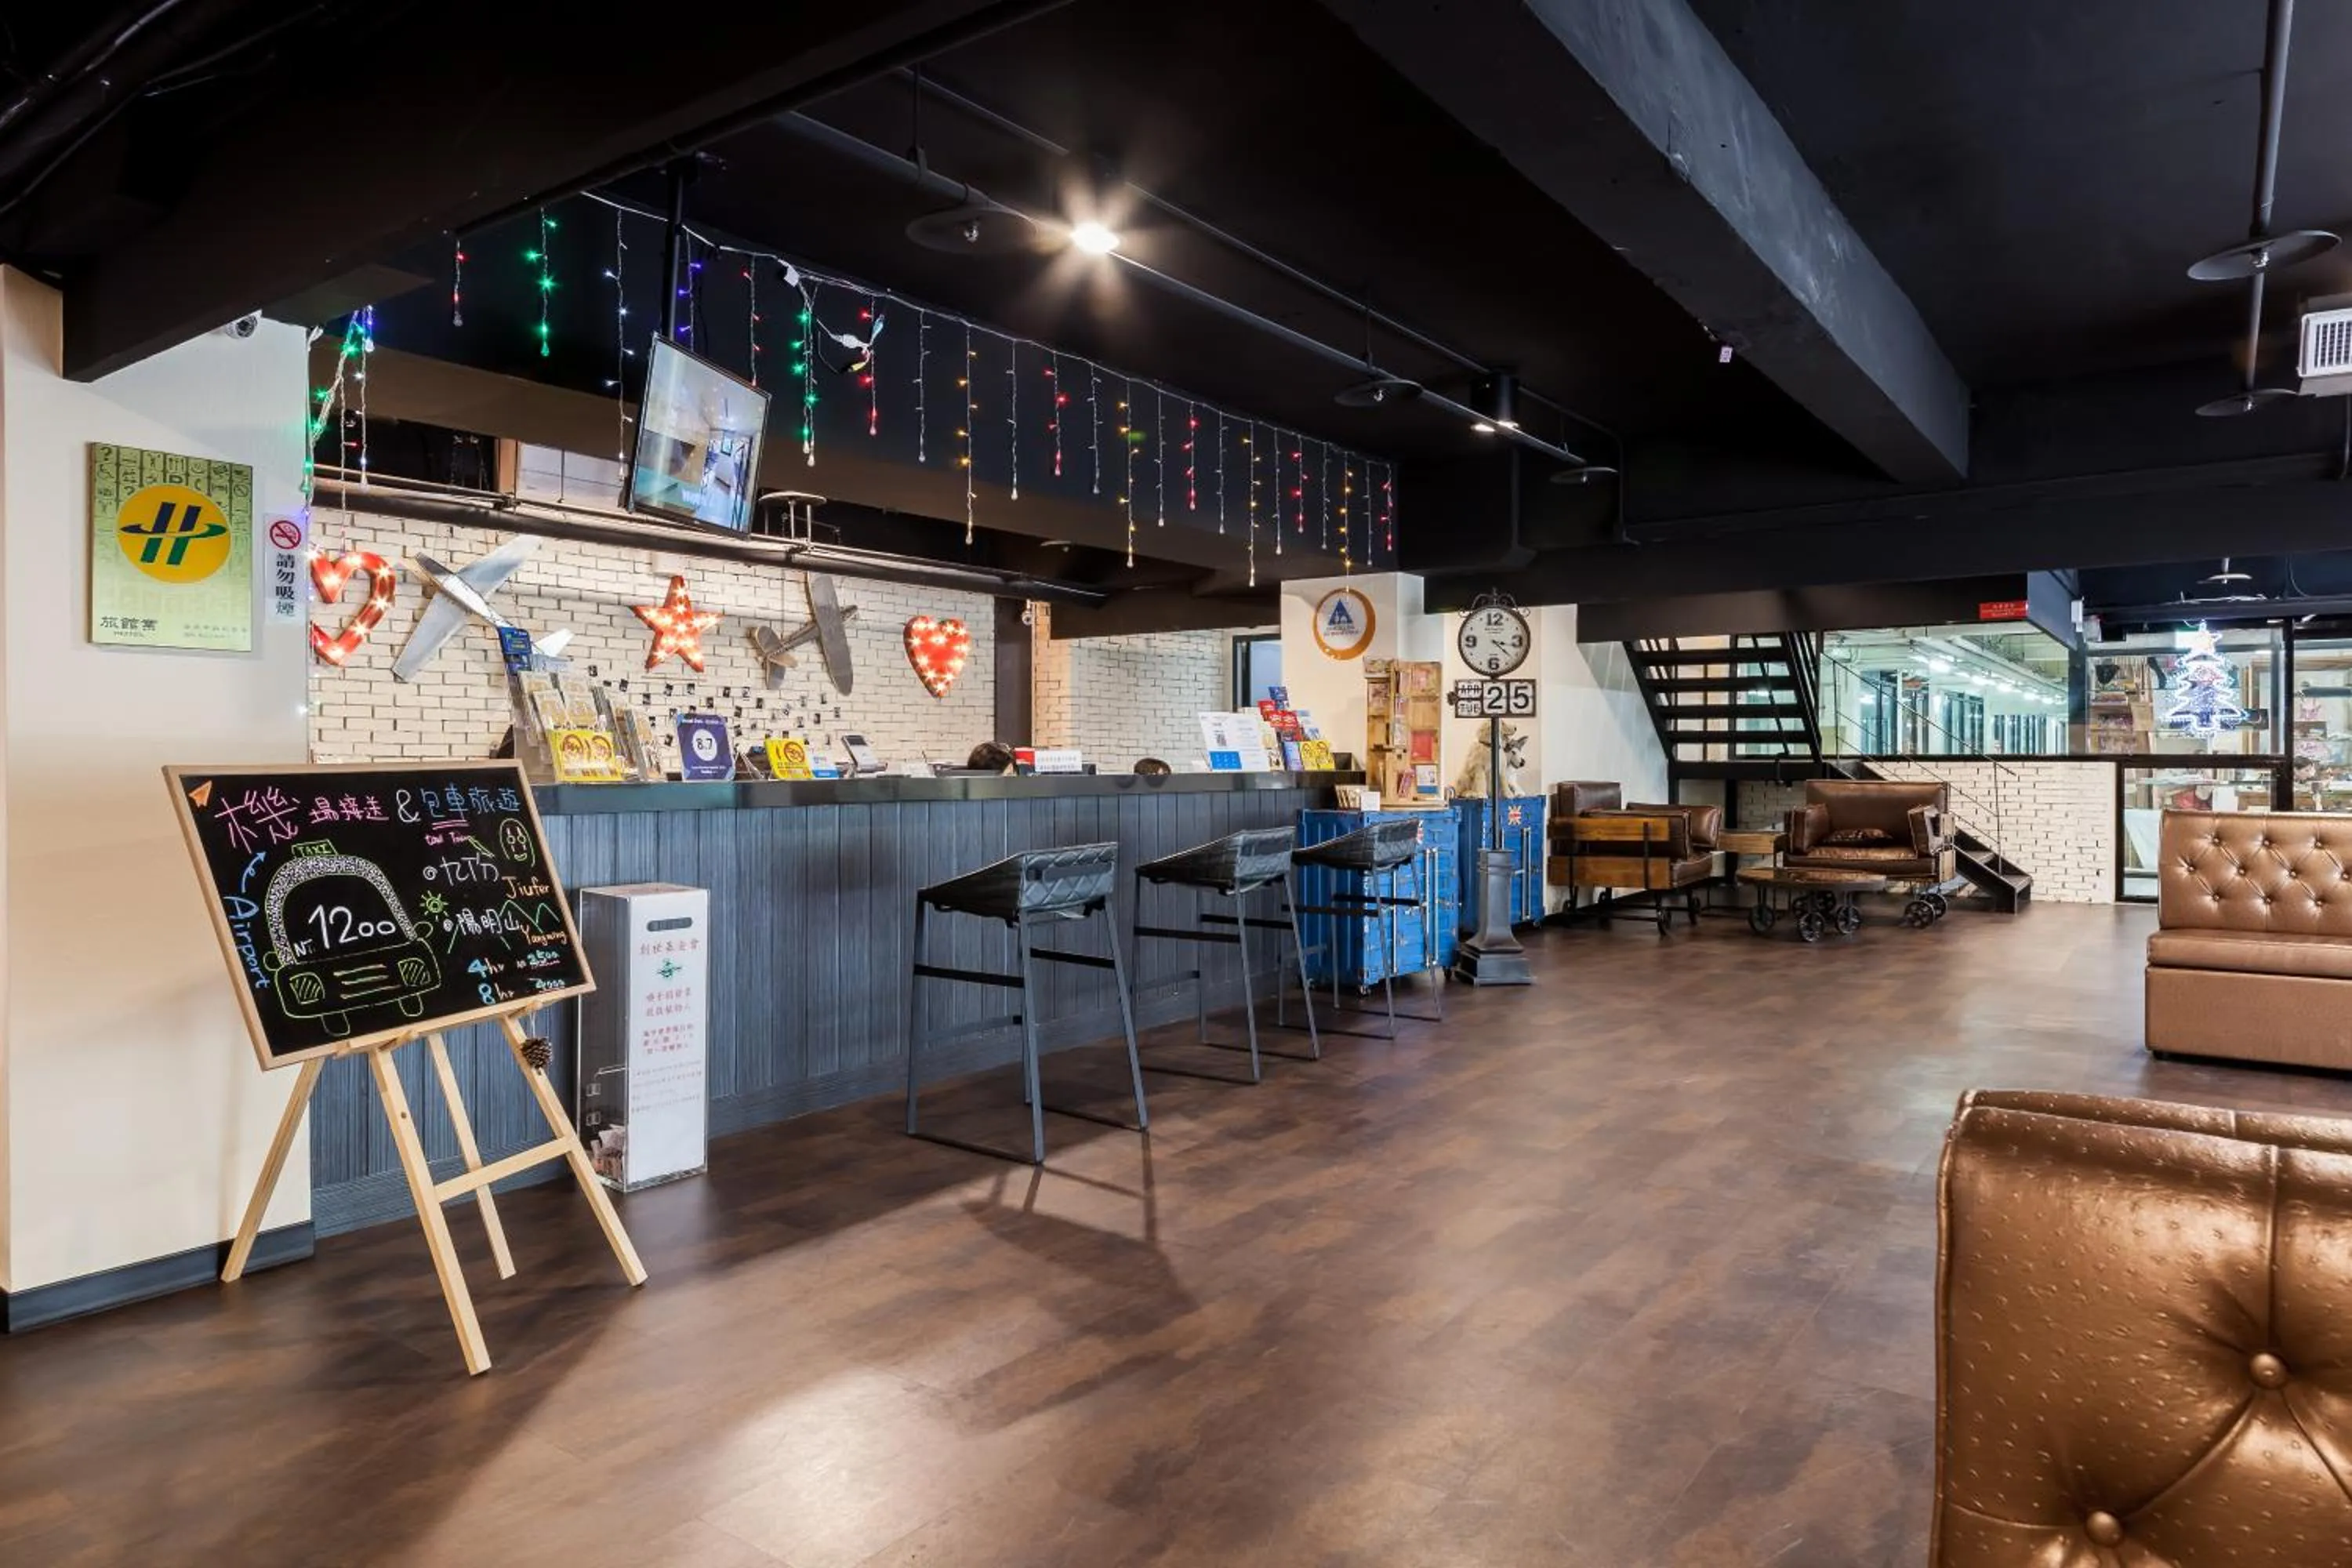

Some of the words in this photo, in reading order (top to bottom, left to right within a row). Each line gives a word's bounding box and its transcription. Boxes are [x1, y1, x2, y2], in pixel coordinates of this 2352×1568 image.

[100, 616, 158, 631] 旅館業
[1486, 613, 1504, 626] 12
[1465, 635, 1477, 648] 9
[1512, 635, 1523, 648] 3
[1489, 657, 1500, 670] 6
[396, 789, 420, 823] &
[298, 843, 332, 857] TAXI
[309, 904, 396, 949] 1200
[223, 896, 270, 989] Airport
